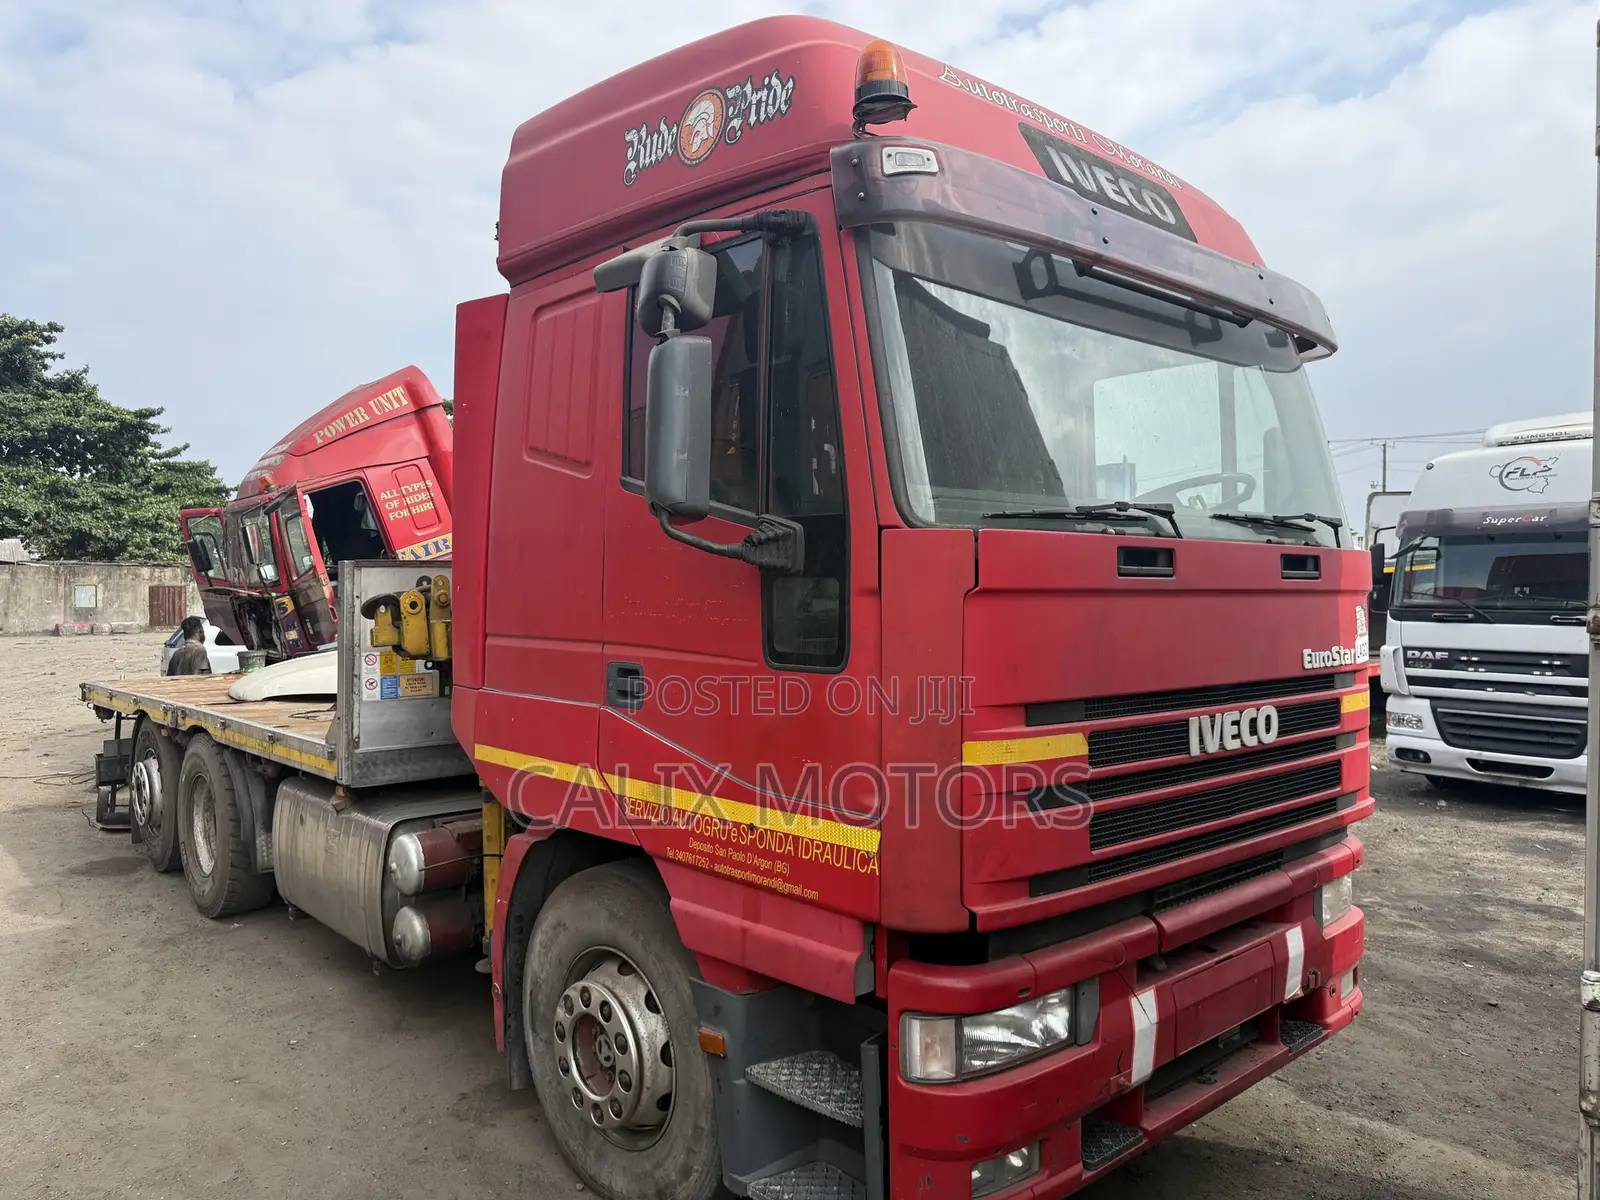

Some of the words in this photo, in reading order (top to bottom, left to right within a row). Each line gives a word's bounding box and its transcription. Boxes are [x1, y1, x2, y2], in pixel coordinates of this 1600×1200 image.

[938, 64, 1087, 144] Autotrasporti
[622, 116, 678, 187] Rude
[725, 68, 796, 145] Pride
[1045, 145, 1176, 226] IVECO
[313, 407, 372, 446] POWER
[368, 385, 409, 417] UNIT
[380, 489, 400, 501] ALL
[400, 479, 433, 495] TYPES
[385, 499, 400, 510] OF
[402, 490, 434, 506] RIDES
[388, 508, 410, 521] FOR
[1482, 513, 1548, 526] SuperCar
[1302, 645, 1355, 670] EuroStar
[1406, 650, 1449, 660] DAF
[1188, 705, 1279, 757] IVECO
[622, 796, 670, 825] SERVIZIO
[739, 824, 795, 857] SPONDA
[798, 838, 880, 876] IDRAULICA
[688, 837, 714, 854] Deposito
[714, 845, 727, 858] San
[728, 848, 746, 863] Paolo
[746, 852, 773, 871] D'Argon
[773, 861, 790, 877] (BG)
